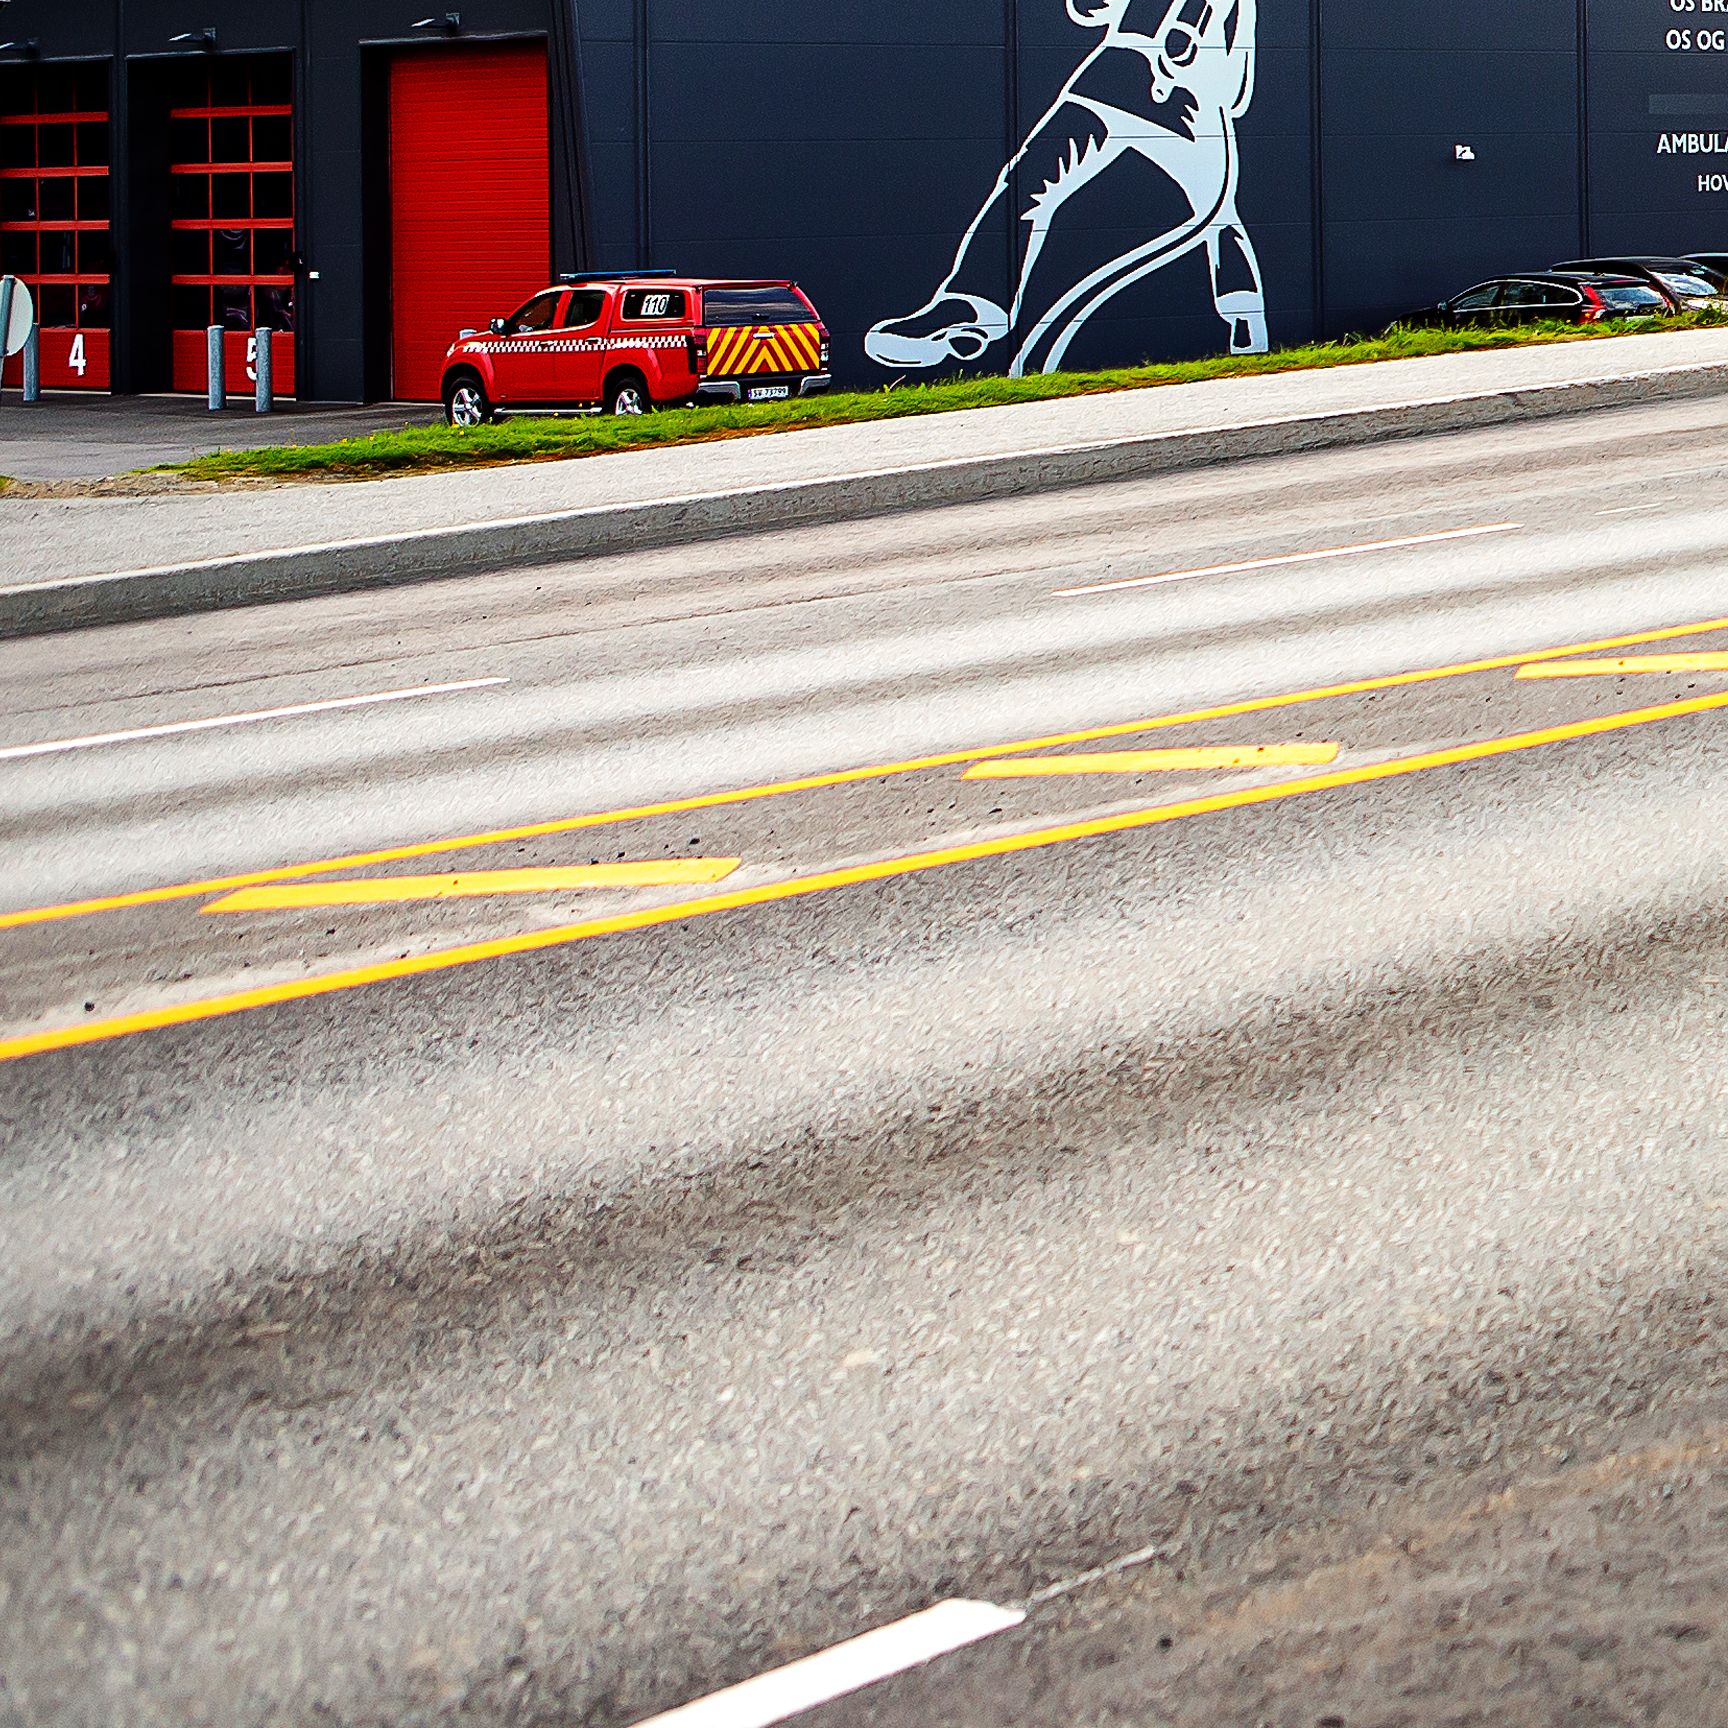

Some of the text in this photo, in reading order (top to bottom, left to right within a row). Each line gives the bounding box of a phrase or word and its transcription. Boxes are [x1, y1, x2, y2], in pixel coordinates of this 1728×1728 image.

[1665, 29, 1691, 50] OS
[1696, 30, 1725, 50] OG
[645, 296, 668, 314] 110
[69, 334, 86, 376] 4
